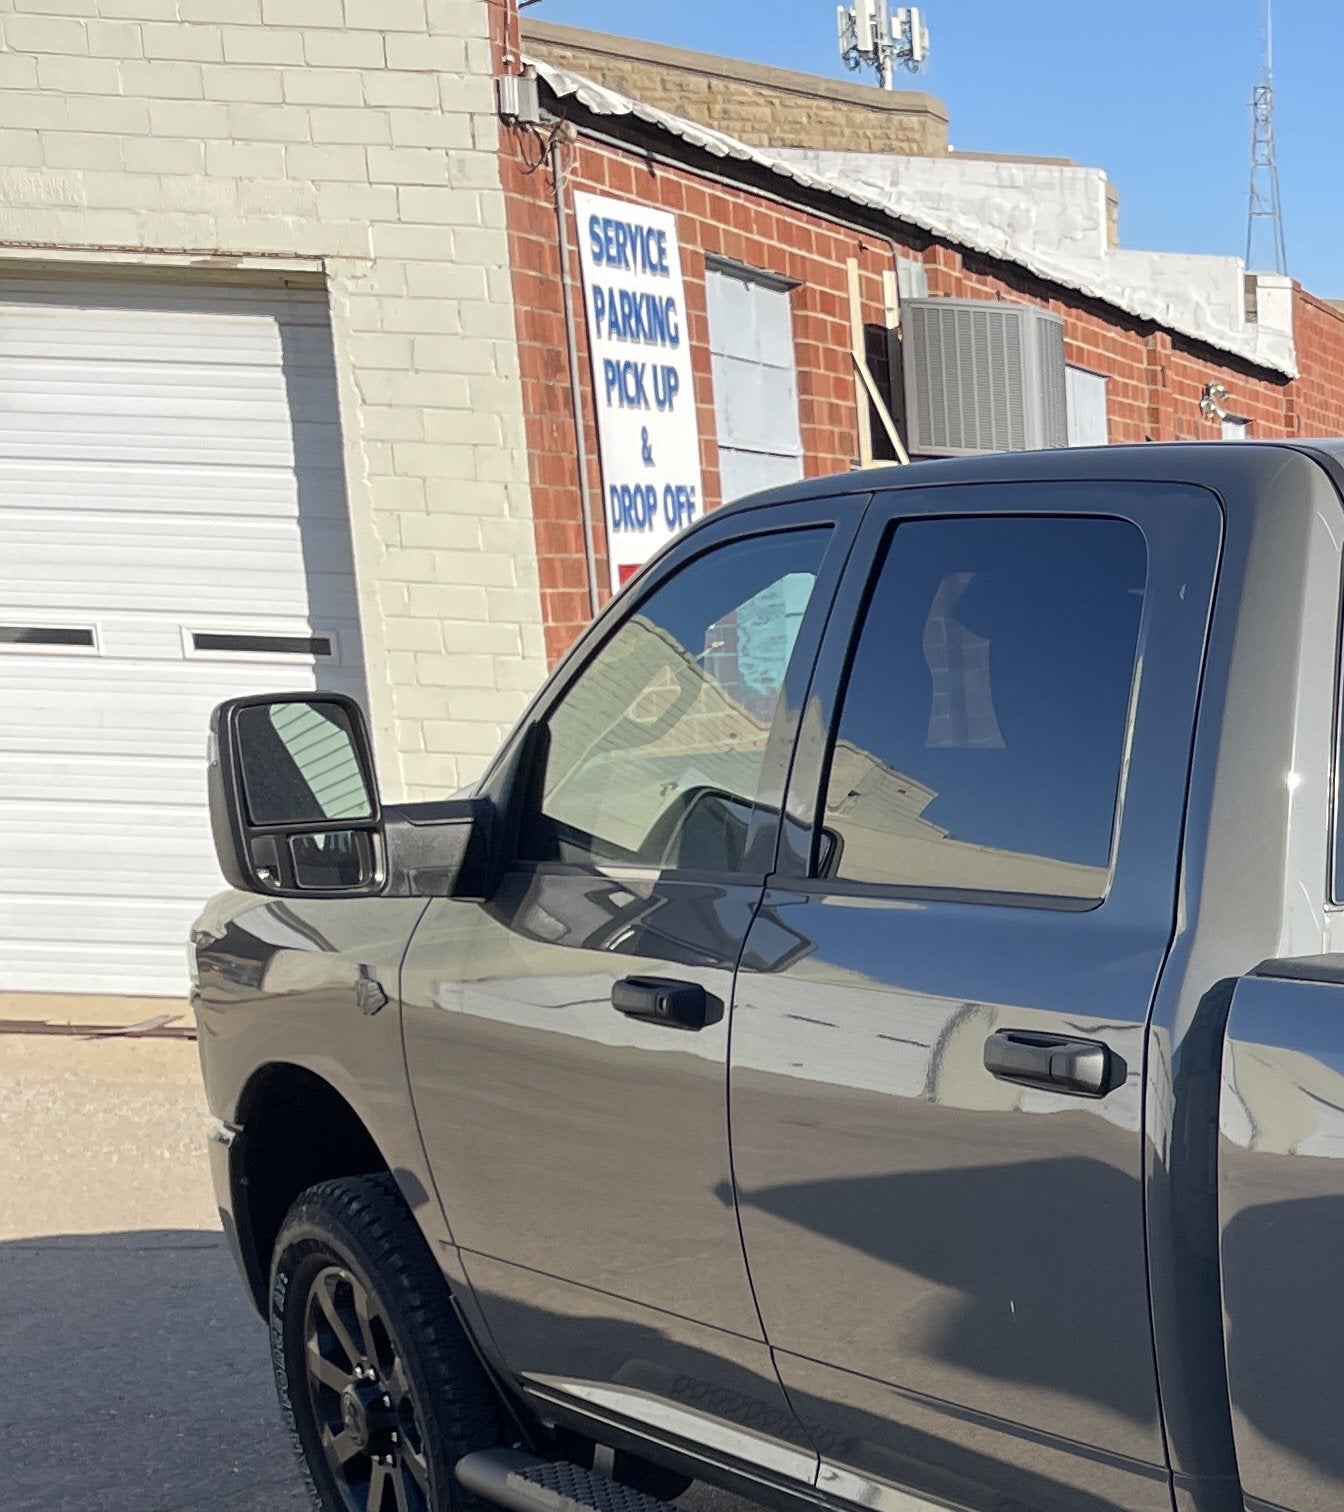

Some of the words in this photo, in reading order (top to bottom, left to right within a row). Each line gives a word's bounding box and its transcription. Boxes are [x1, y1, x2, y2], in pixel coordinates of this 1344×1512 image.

[589, 213, 670, 278] SERVICE
[591, 284, 680, 349] PARKING
[603, 357, 650, 410] PICK
[652, 363, 680, 412] UP
[641, 425, 656, 467] &
[609, 483, 657, 533] DROP
[664, 483, 696, 532] OFF
